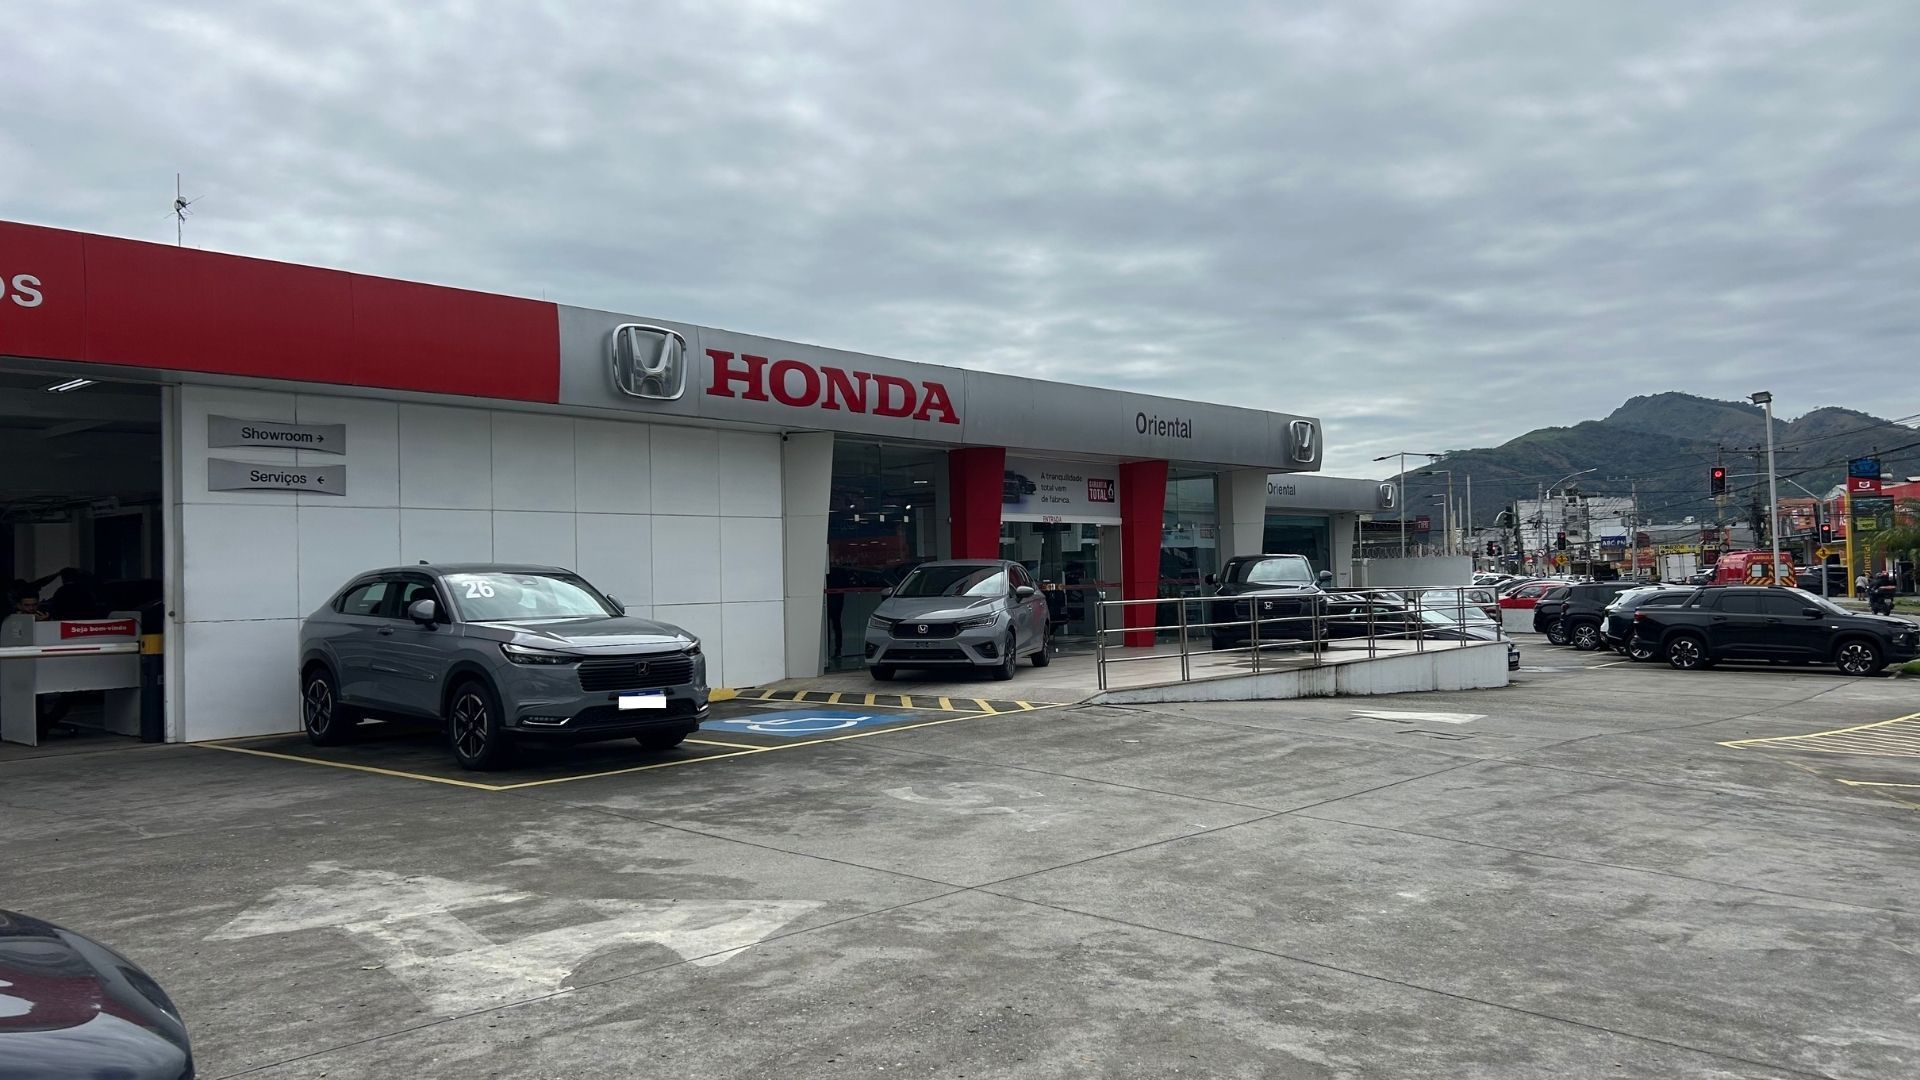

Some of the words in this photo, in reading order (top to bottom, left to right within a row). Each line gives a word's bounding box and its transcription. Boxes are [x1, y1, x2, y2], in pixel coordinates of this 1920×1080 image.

[0, 274, 43, 307] s
[705, 348, 960, 424] HONDA
[1136, 412, 1192, 439] Oriental
[241, 427, 313, 444] Showroom
[250, 470, 307, 486] Serviços
[1090, 489, 1107, 500] TOTAL
[1267, 482, 1296, 496] Oriental
[461, 580, 495, 599] 26
